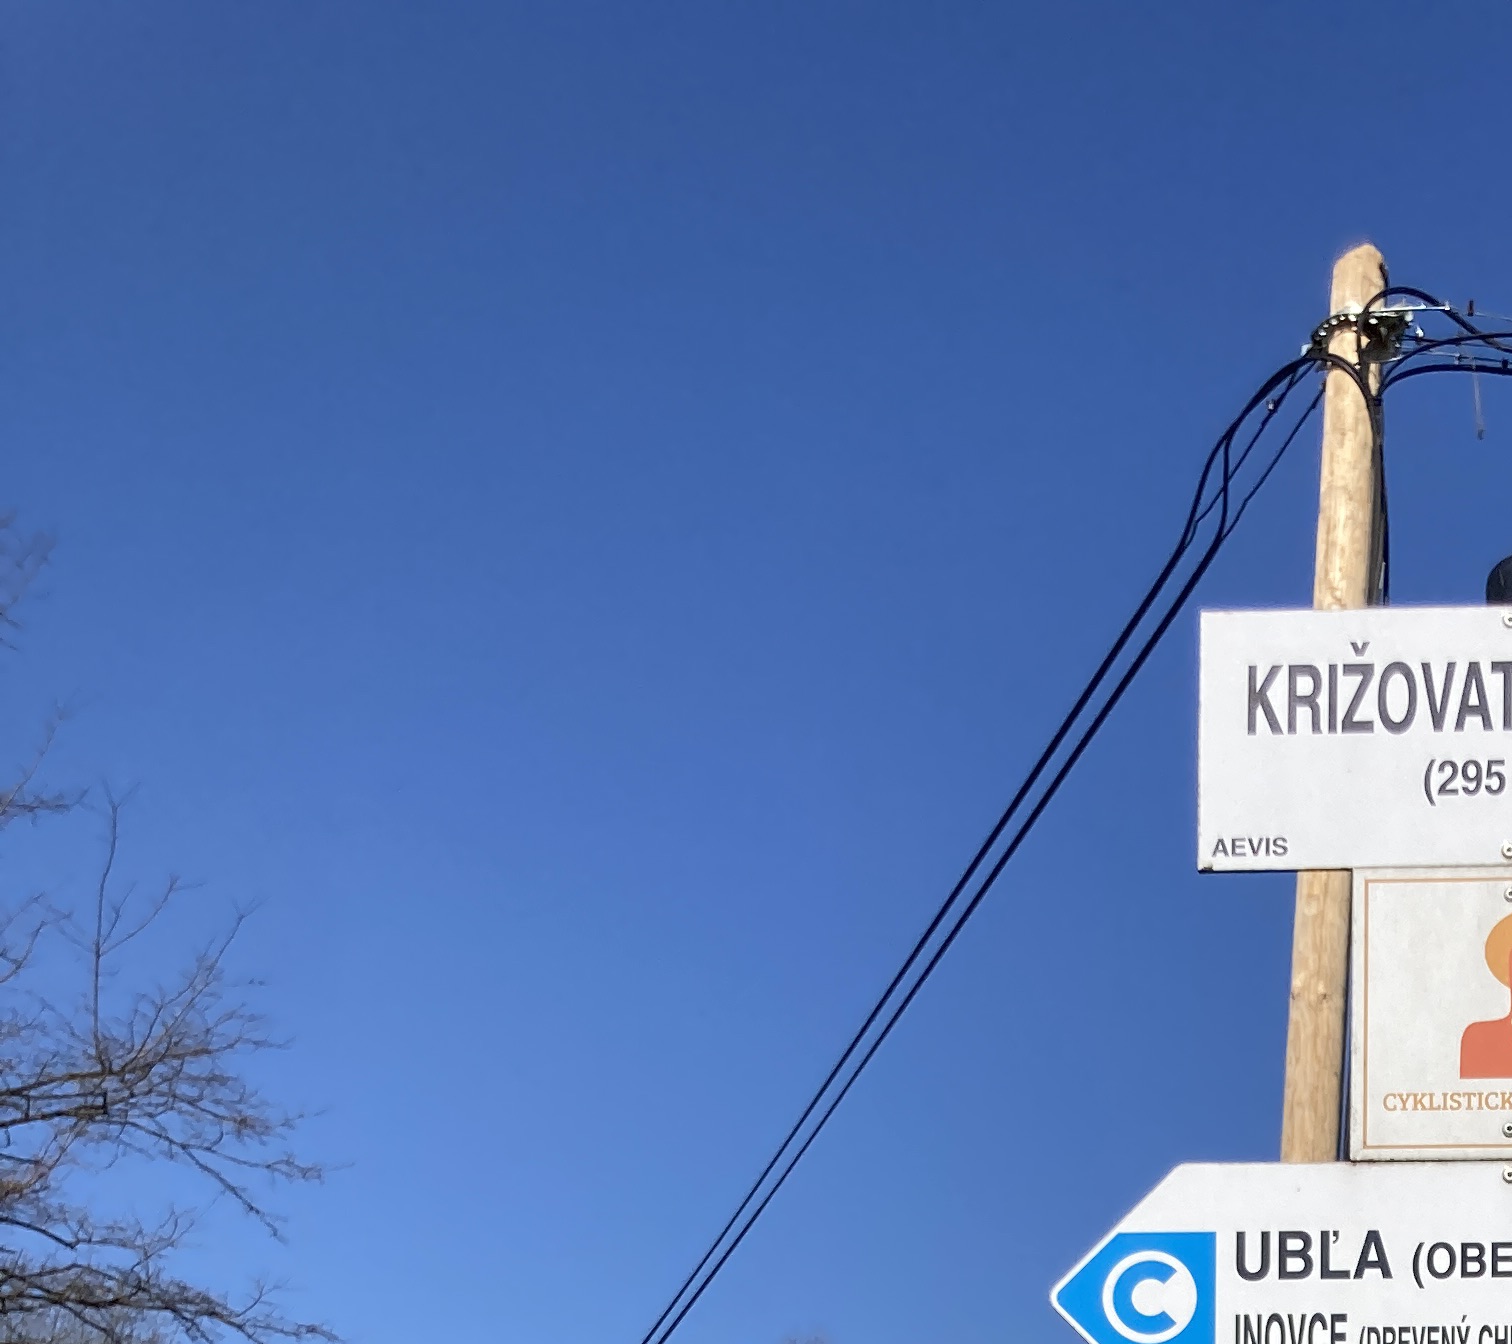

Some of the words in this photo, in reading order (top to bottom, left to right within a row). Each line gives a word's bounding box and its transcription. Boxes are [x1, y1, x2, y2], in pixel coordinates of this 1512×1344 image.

[1424, 759, 1505, 805] (295
[1213, 838, 1287, 856] AEVIS
[1236, 1230, 1392, 1281] UBĽA
